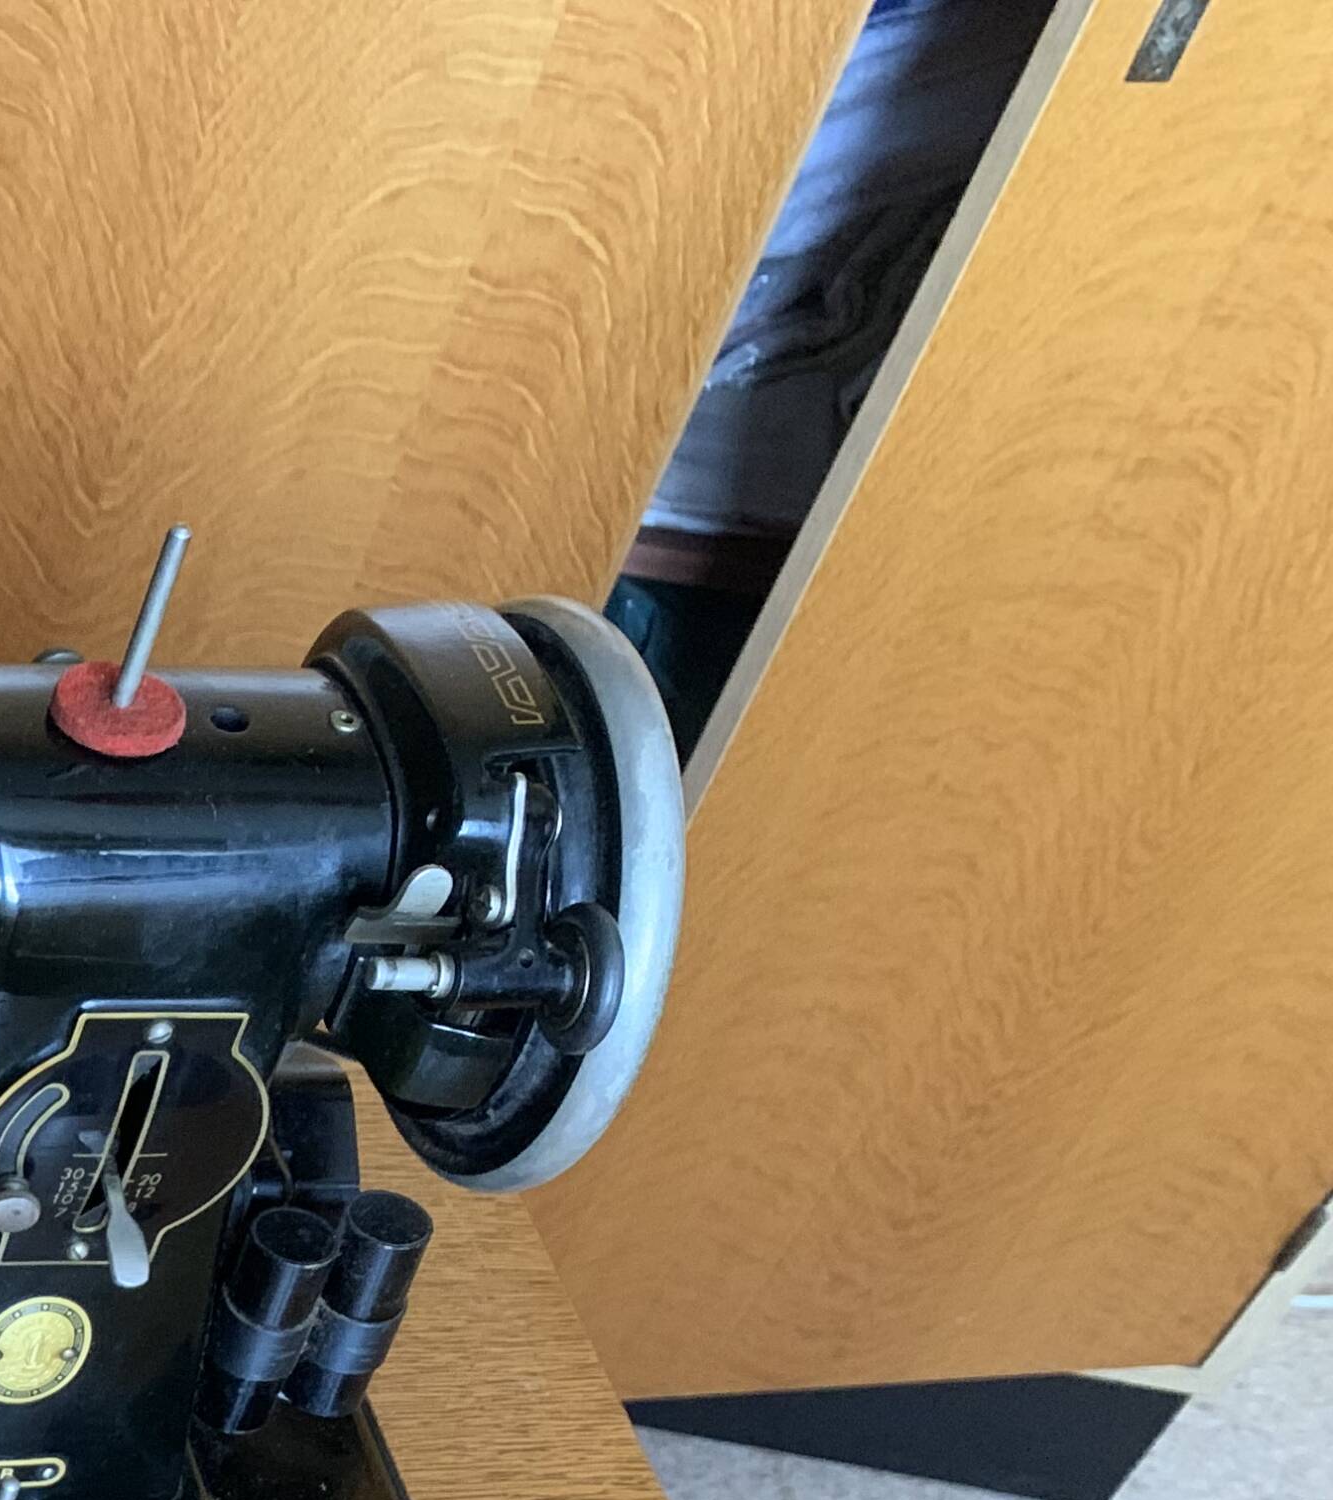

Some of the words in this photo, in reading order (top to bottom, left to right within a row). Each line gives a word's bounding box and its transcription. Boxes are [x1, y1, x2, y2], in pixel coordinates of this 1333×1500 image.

[61, 1167, 85, 1180] 30
[138, 1172, 162, 1186] 20
[135, 1186, 156, 1199] 12
[54, 1206, 68, 1218] 7
